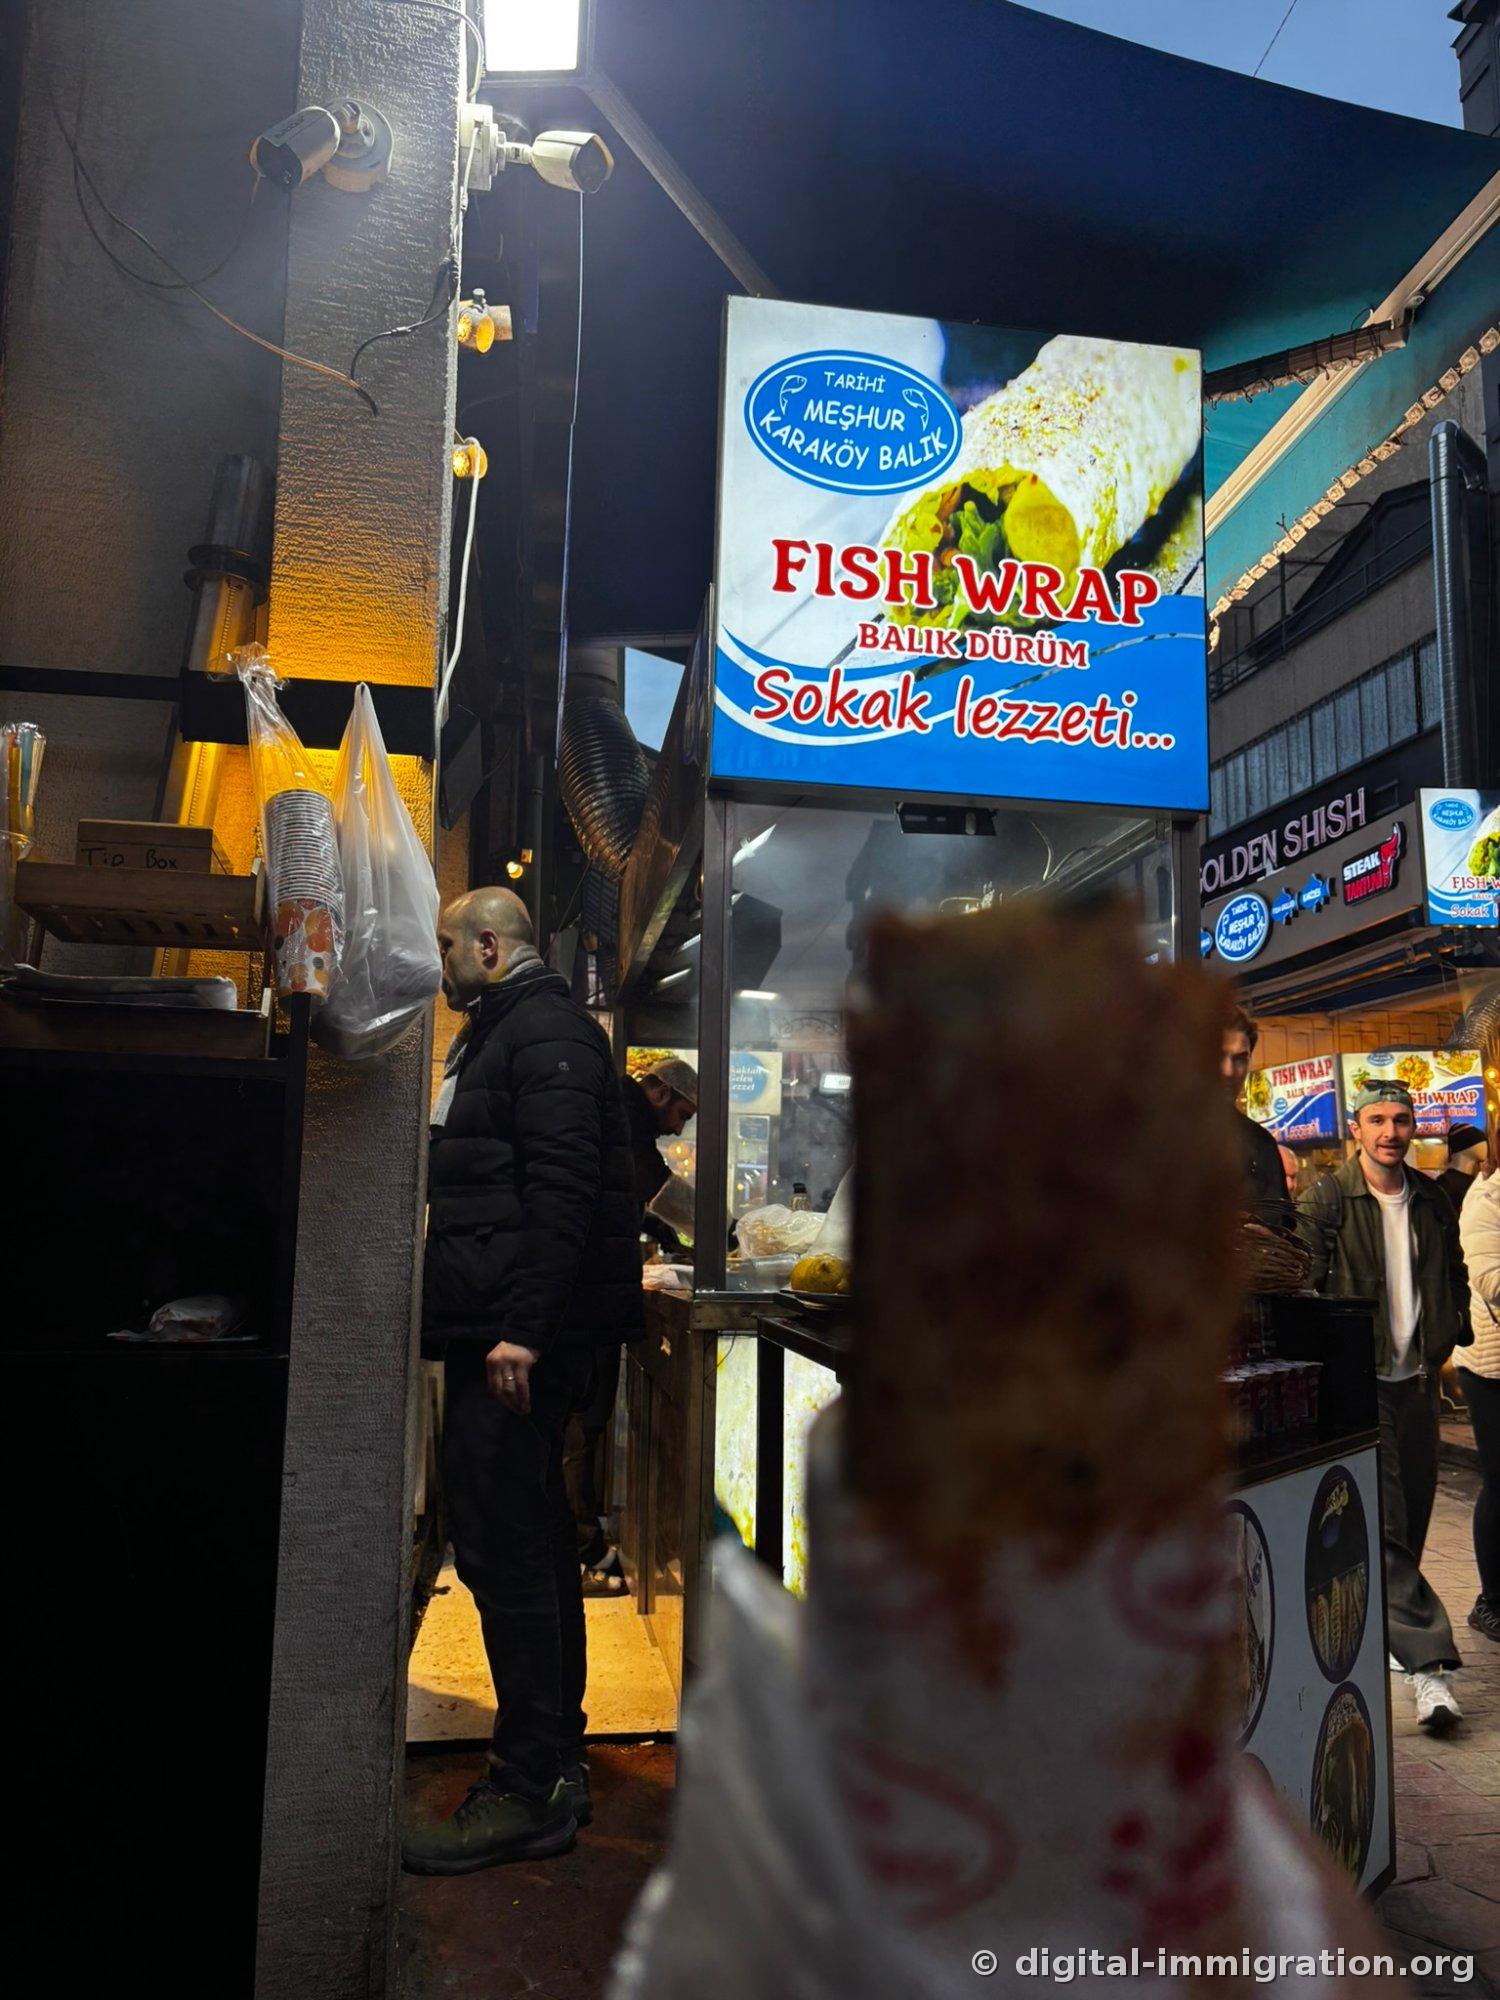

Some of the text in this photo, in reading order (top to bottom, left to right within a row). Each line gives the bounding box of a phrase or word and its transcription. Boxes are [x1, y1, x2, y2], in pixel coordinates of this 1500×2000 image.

[823, 371, 887, 394] TARİHİ
[803, 399, 906, 432] MEŞHUR
[759, 408, 949, 471] KARAKÖY BALIK
[772, 538, 1160, 626] FISH WRAP
[858, 622, 1088, 668] BALIK DÜRÜM
[753, 668, 1175, 749] Sokak lezzeti...
[1200, 787, 1366, 893] OLDEN SHISH
[145, 848, 178, 869] Box
[1343, 851, 1381, 881] STEAK
[1451, 876, 1487, 889] FISH
[1451, 903, 1489, 918] Sokak
[1272, 1058, 1332, 1086] FISH WRAP
[1431, 1090, 1478, 1105] WRAP
